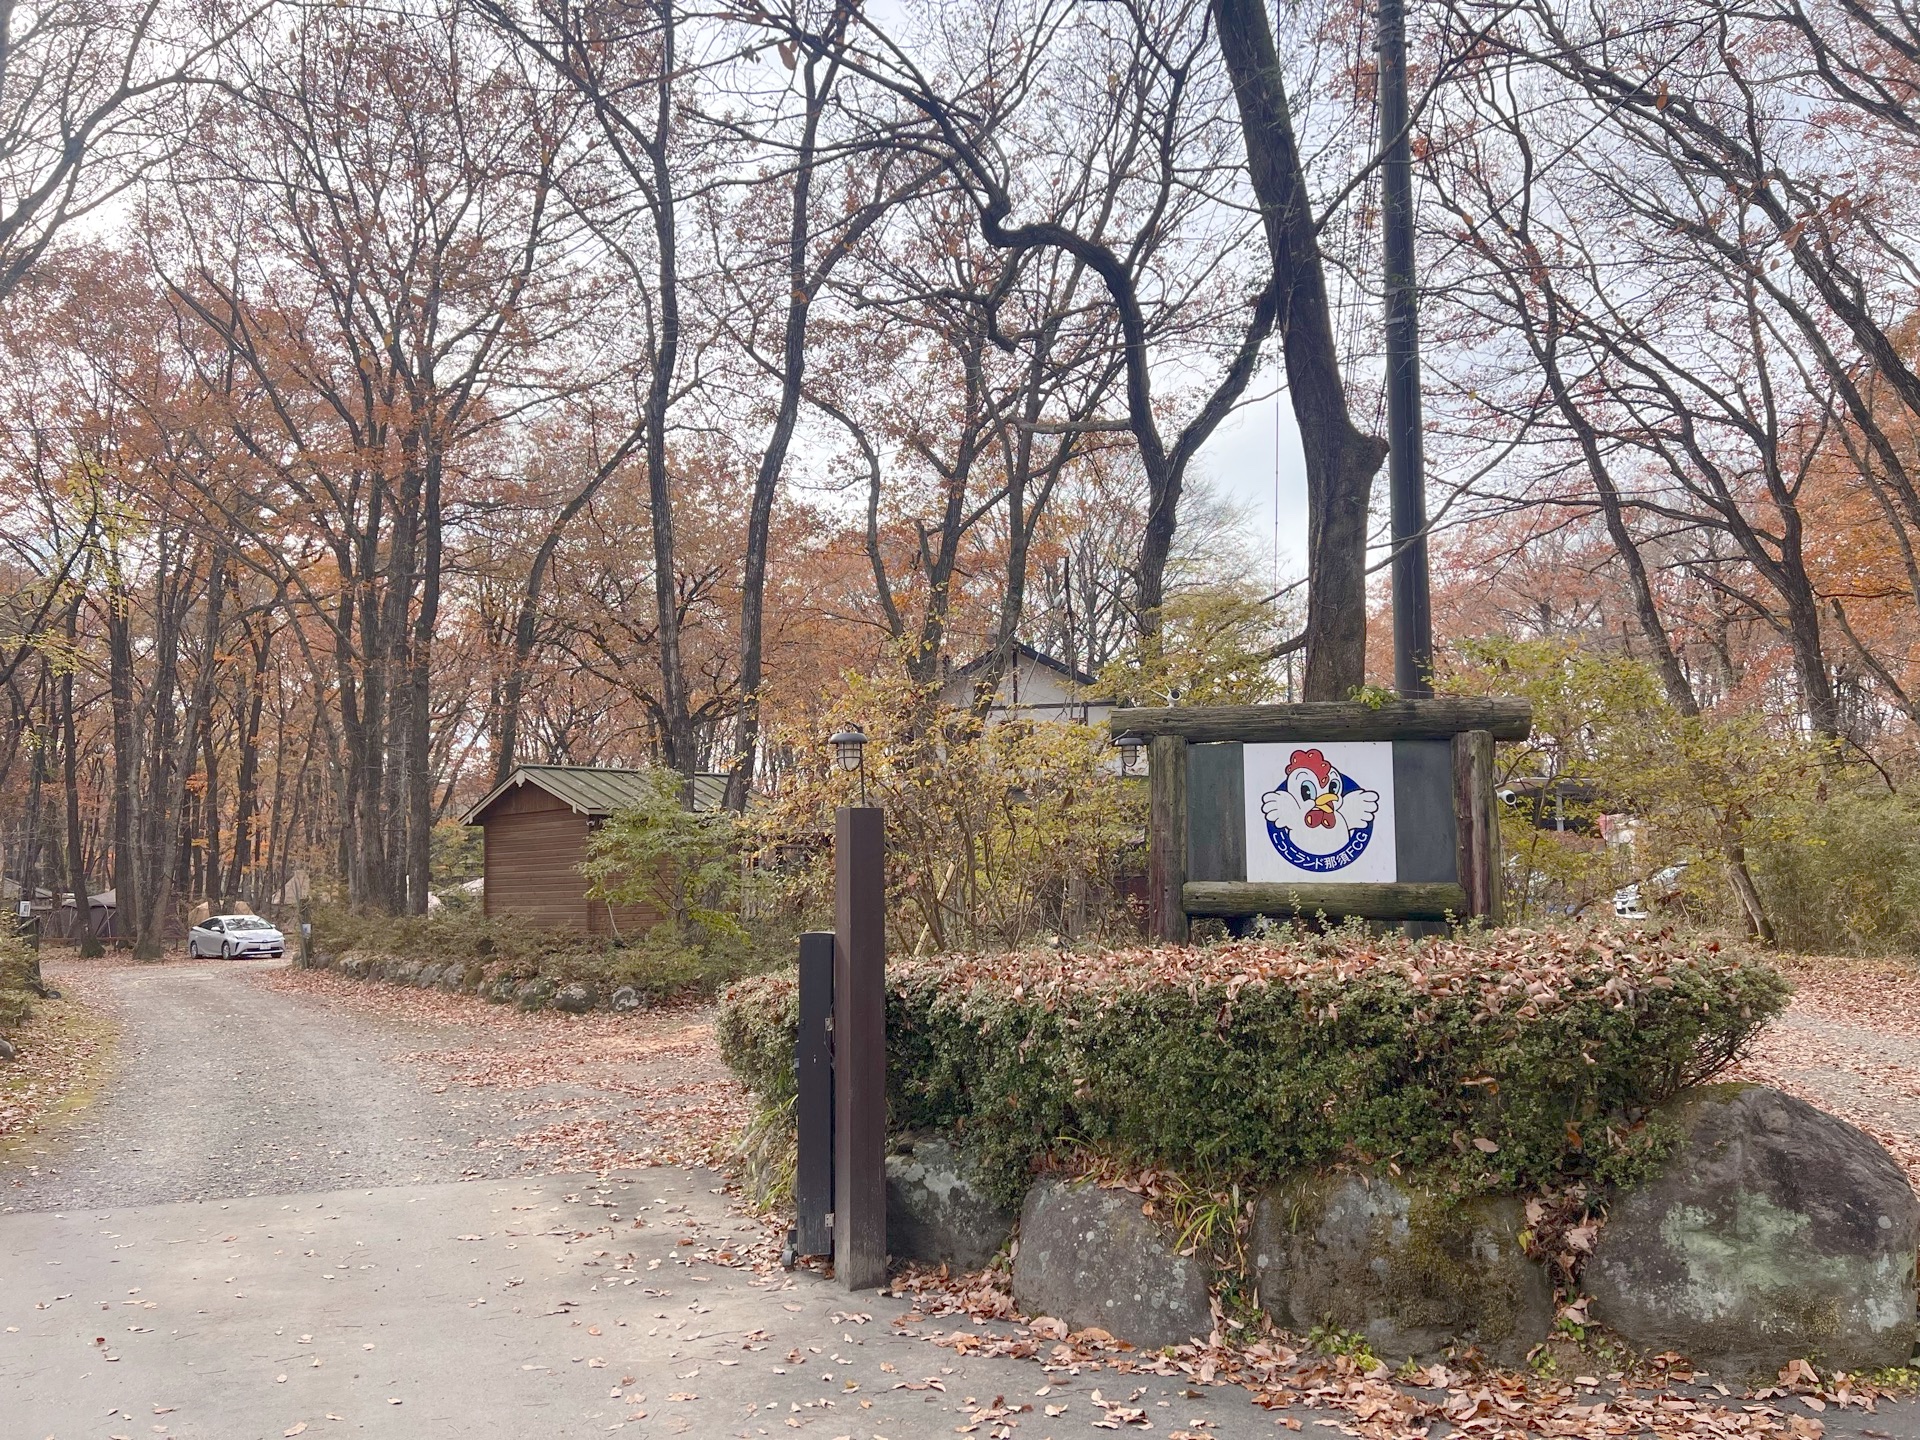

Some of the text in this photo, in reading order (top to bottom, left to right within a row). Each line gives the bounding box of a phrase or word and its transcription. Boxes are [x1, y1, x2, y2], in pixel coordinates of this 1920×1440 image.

[1272, 831, 1368, 869] こっこランド那須FCG
